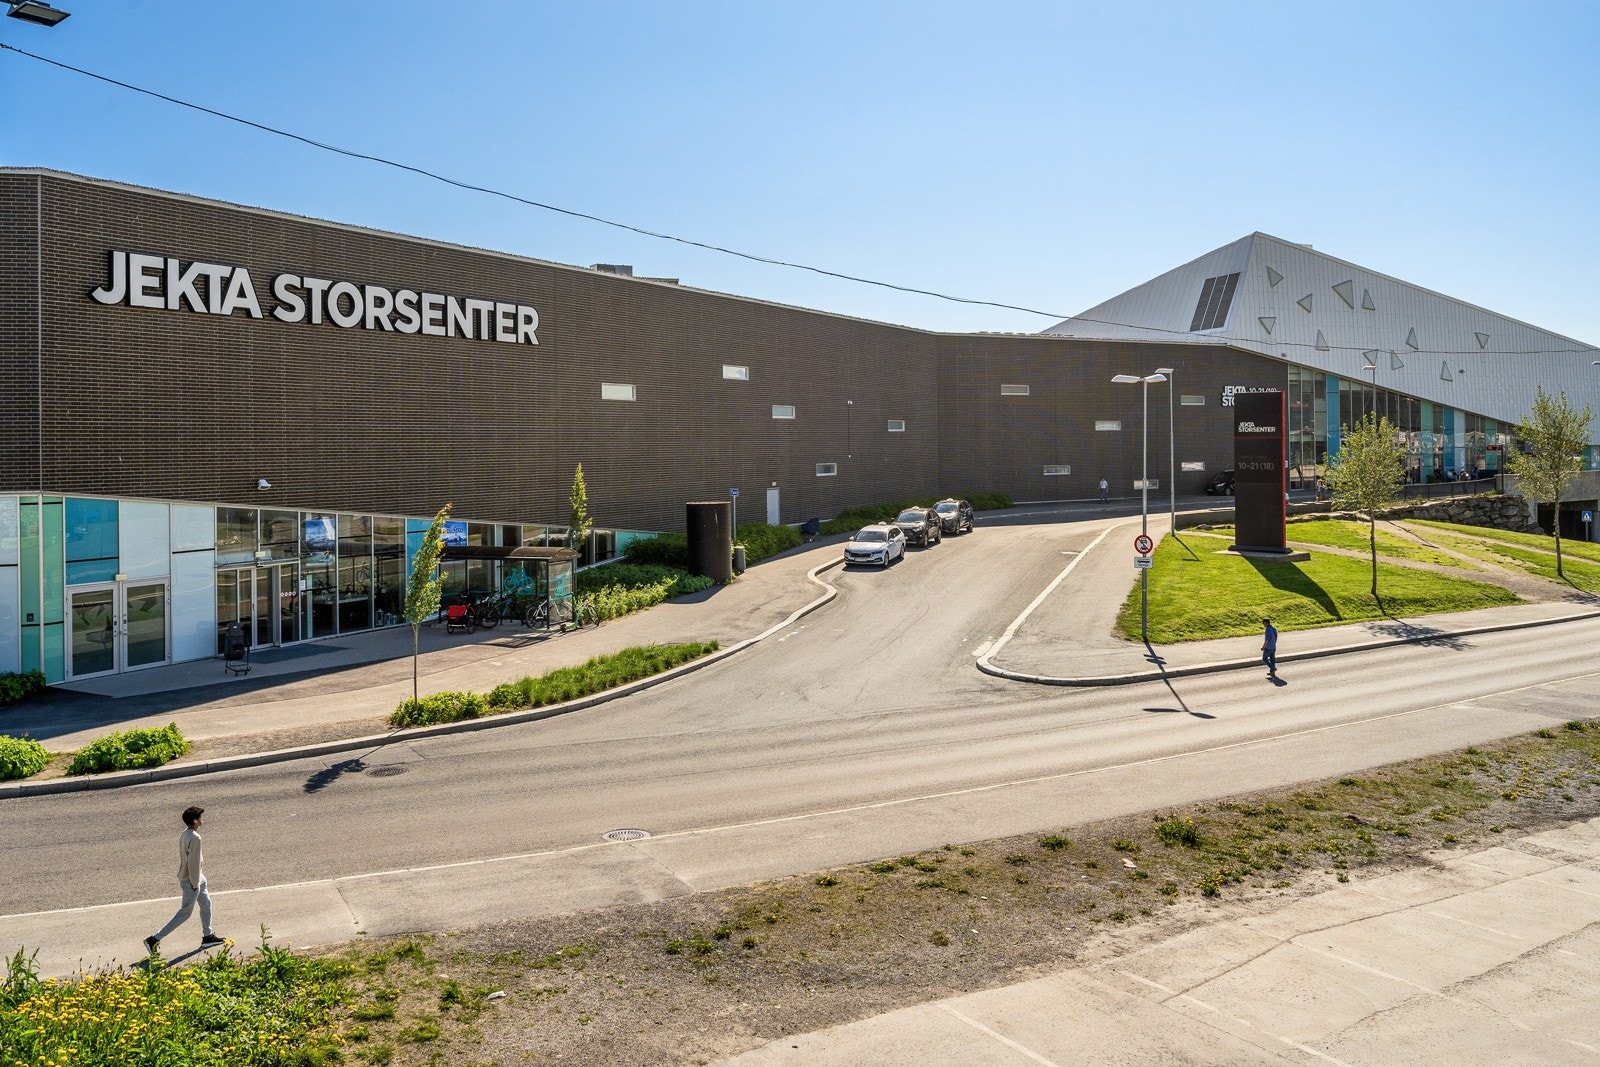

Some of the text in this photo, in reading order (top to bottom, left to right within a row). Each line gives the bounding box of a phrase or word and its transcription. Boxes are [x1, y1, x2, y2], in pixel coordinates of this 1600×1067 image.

[92, 250, 540, 346] JEKTA STORSENTER
[1222, 386, 1246, 396] JEKTA
